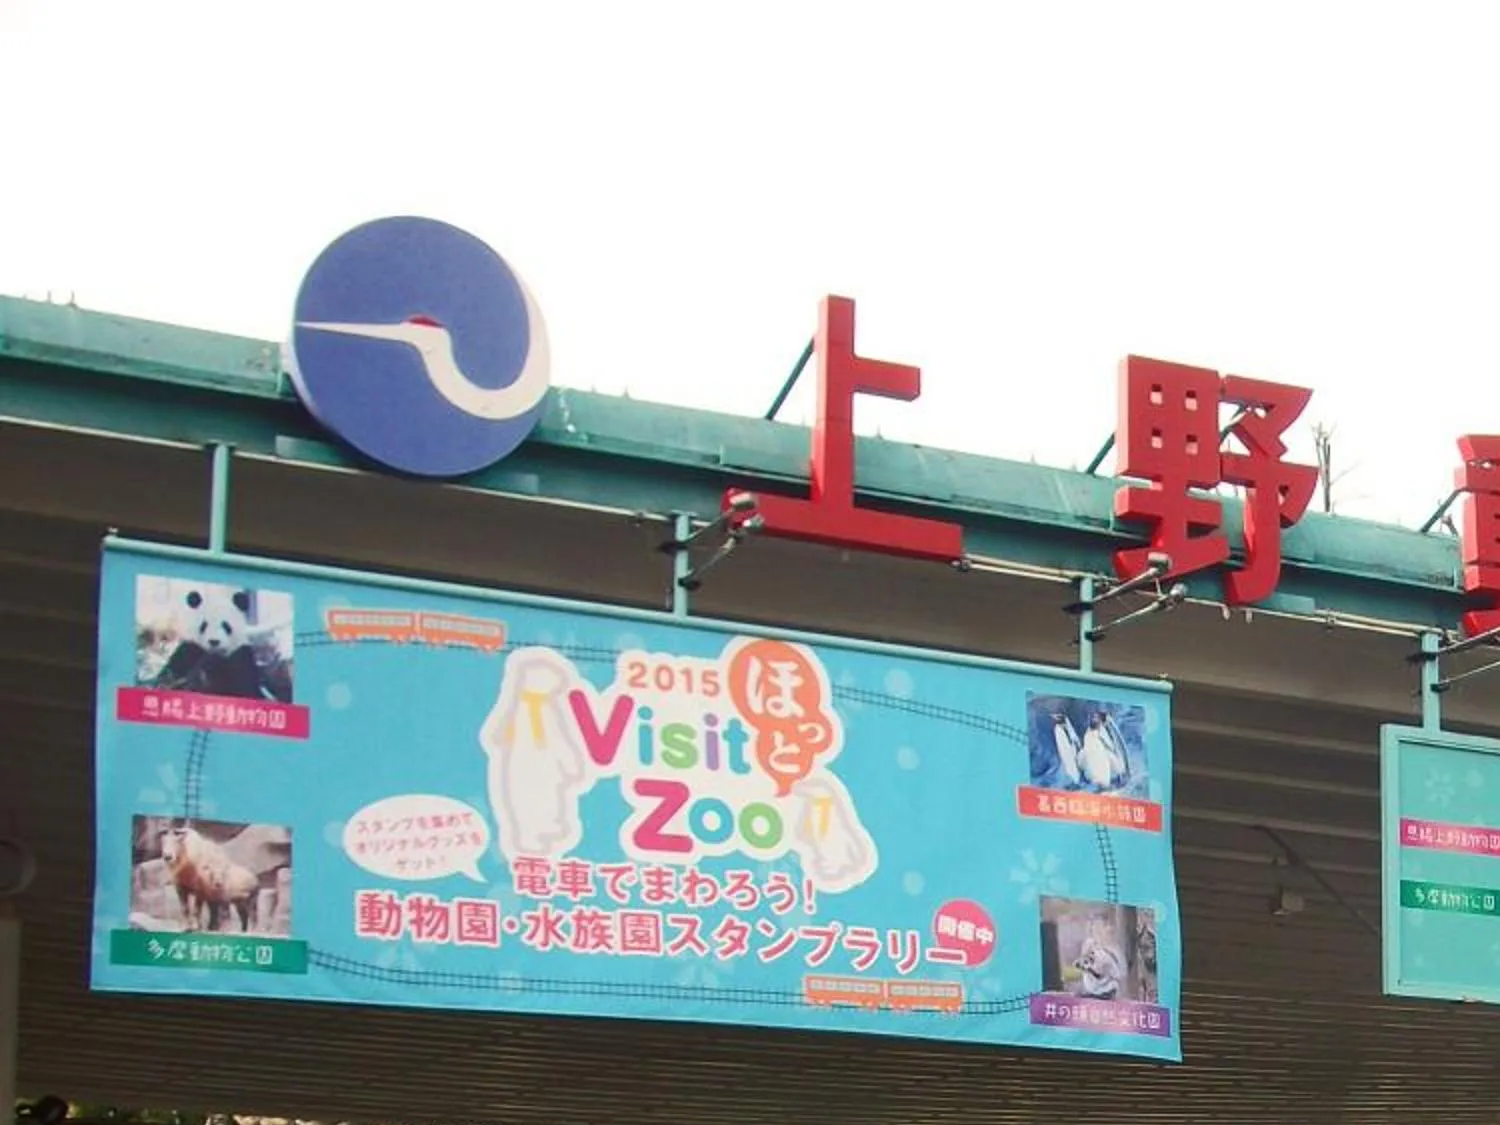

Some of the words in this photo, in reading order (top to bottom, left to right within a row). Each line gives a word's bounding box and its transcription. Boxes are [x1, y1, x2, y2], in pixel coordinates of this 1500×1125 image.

[627, 662, 721, 698] 2015
[746, 654, 825, 775] ほっと
[568, 688, 753, 776] Visit
[632, 777, 785, 855] Zoo
[512, 855, 817, 915] 電車でまわろう!
[355, 892, 968, 974] 動物園・水族園スタンプラリー
